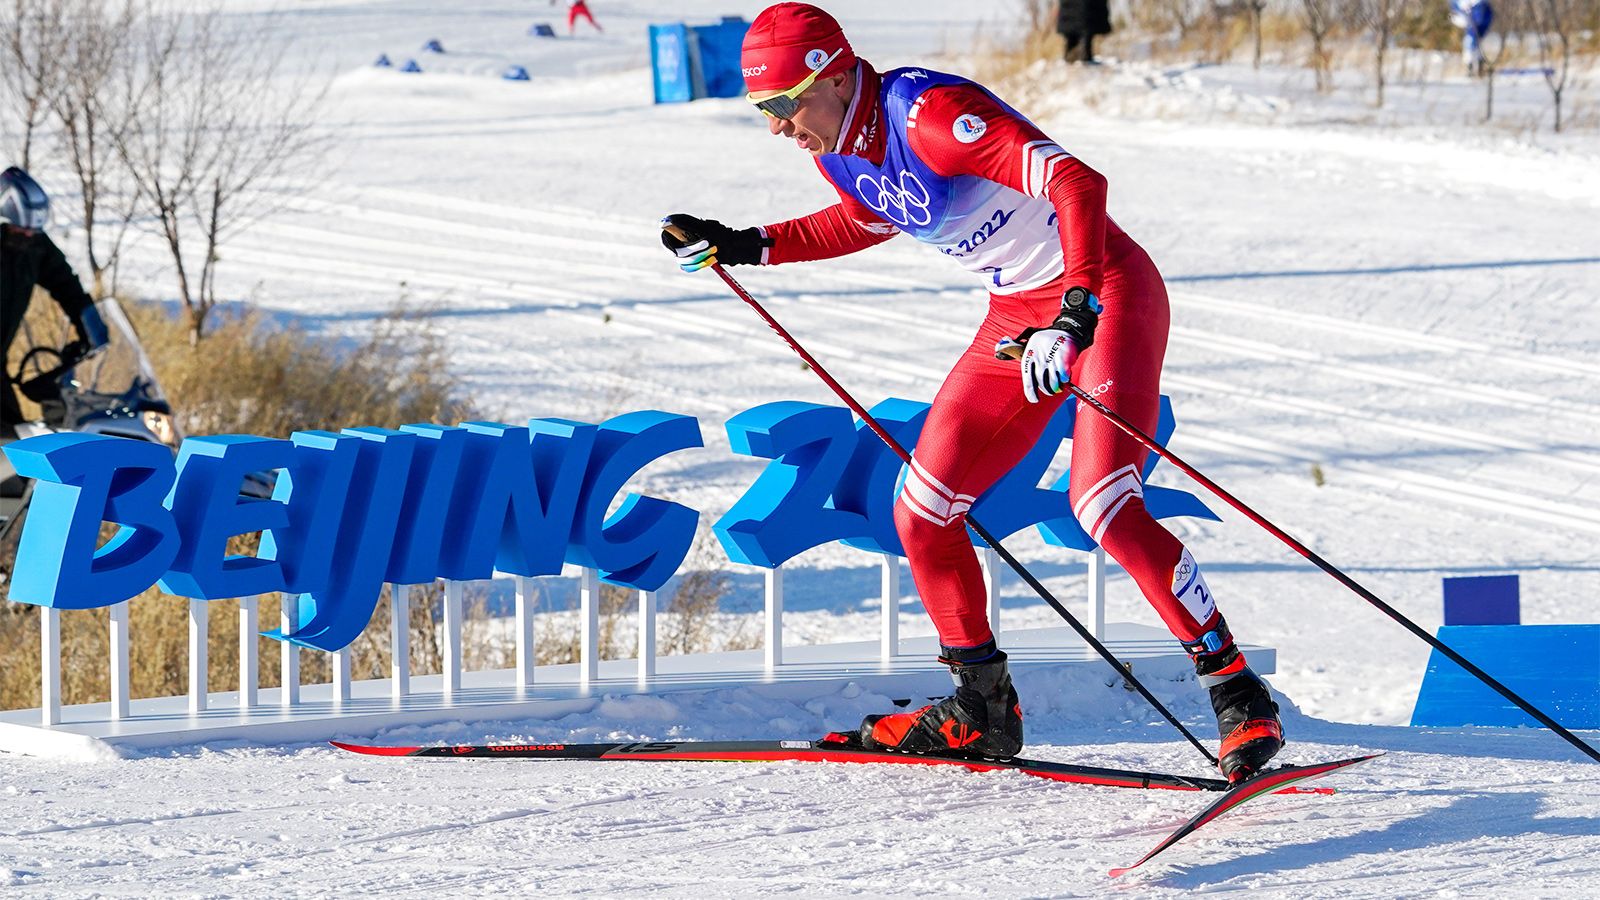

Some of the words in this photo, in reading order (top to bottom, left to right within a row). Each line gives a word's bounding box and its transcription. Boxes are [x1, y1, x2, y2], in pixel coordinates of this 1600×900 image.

[958, 208, 1017, 253] 2022
[2, 409, 705, 652] BEIJING
[1194, 584, 1209, 605] 2
